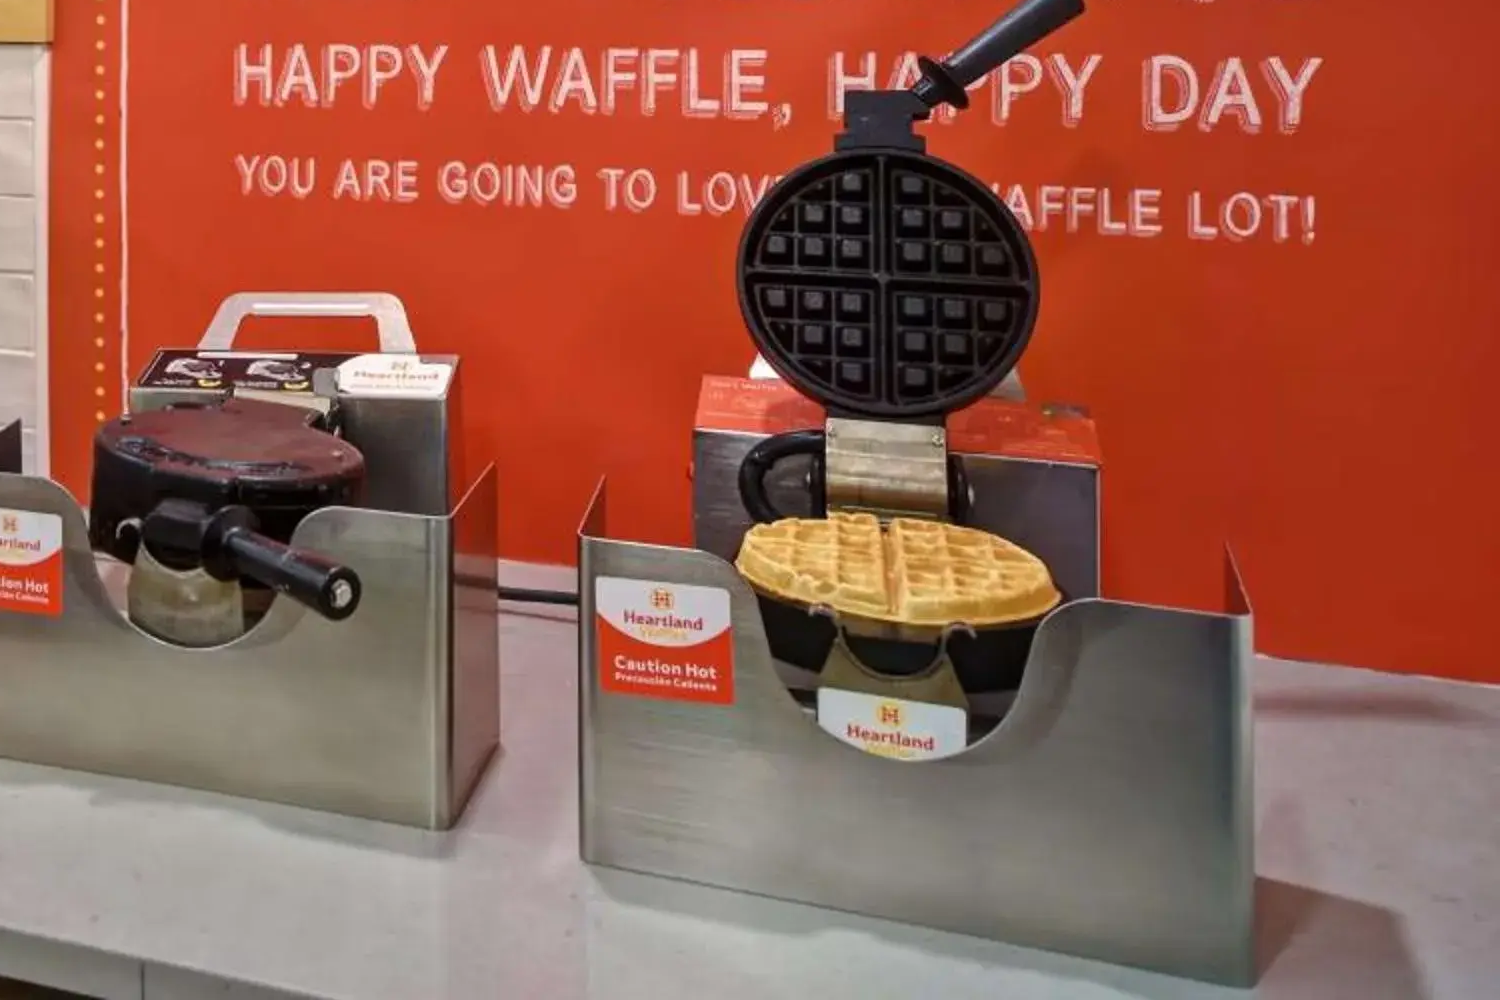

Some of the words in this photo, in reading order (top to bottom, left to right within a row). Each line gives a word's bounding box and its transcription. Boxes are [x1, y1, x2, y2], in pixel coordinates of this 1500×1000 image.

[234, 43, 448, 110] HAPPY
[479, 44, 792, 132] WAFFLE,
[827, 50, 1103, 128] HAPY
[1142, 54, 1323, 136] DAY
[234, 154, 316, 200] YOU
[333, 158, 419, 201] ARE
[437, 160, 578, 208] GOING
[597, 167, 658, 213] TO
[676, 170, 784, 217] LOV
[987, 180, 1164, 237] AFFLE
[1187, 190, 1316, 245] LOT!
[24, 576, 49, 595] Hot
[623, 608, 704, 632] Heartland
[613, 655, 681, 675] Caution
[685, 662, 718, 680] Hot
[846, 722, 936, 751] Heartland
